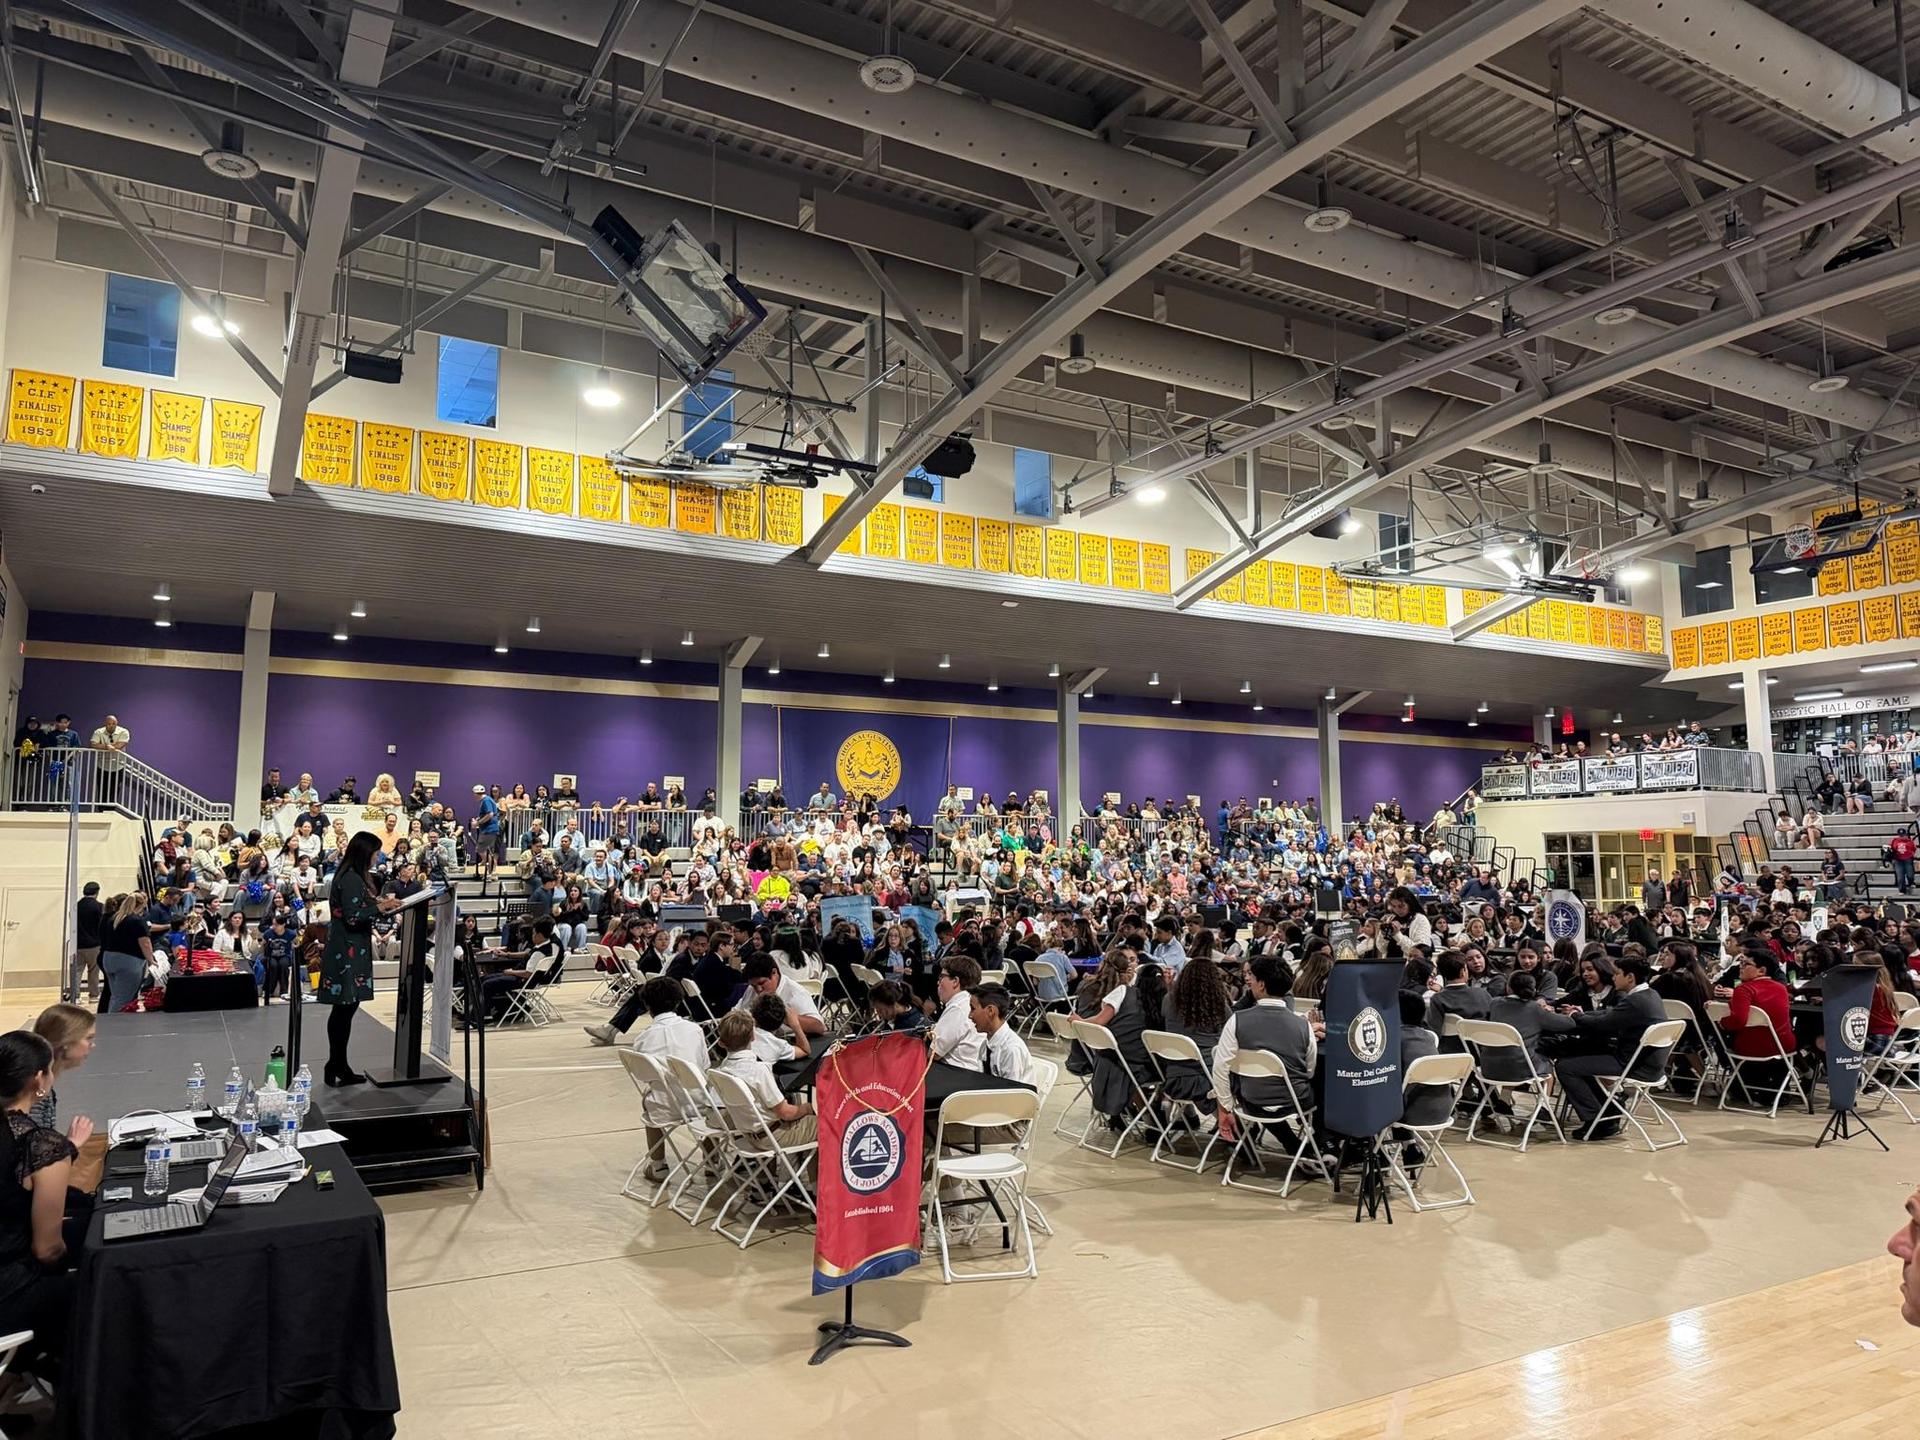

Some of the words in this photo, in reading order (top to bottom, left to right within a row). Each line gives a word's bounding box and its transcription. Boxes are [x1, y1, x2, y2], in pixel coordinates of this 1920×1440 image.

[18, 400, 62, 413] FINALIST
[14, 413, 64, 425] BASKETBALL
[91, 410, 133, 423] FINALIST
[93, 423, 129, 434] FOOTBALL
[160, 422, 192, 433] CHAMPS
[95, 435, 125, 446] 1967
[221, 430, 250, 442] CHAMPS
[311, 442, 348, 453] FINALIST
[225, 451, 244, 461] 1970
[369, 450, 405, 461] FINALIST
[375, 462, 398, 471] TENNIS
[427, 458, 461, 470] FINALIST
[316, 465, 339, 475] 1971
[432, 470, 454, 478] TENNIS
[481, 466, 515, 477] FINALIST
[374, 474, 401, 483] 1986
[534, 474, 567, 485] FINALIST
[431, 481, 456, 490] 1987
[585, 482, 616, 492] FINALIST
[485, 489, 510, 497] 1989
[635, 489, 664, 499] FINALIST
[539, 496, 562, 505] 1990
[677, 495, 714, 506] CHAMPS
[944, 534, 972, 543] CHAMPS
[1894, 554, 1916, 563] FINALIST
[1854, 560, 1882, 570] CHAMPS
[1822, 568, 1843, 576] FINALIST
[1831, 617, 1859, 626] CHAMPS
[1869, 614, 1892, 622] FINALIST
[1800, 624, 1820, 632] FINALIST
[1703, 639, 1727, 647] CHAMPS
[1821, 702, 1850, 713] HALL
[1855, 700, 1871, 710] OF
[1877, 696, 1910, 708] FAME
[840, 738, 857, 766] SCHOLA
[1587, 767, 1606, 784] SAN
[1606, 765, 1634, 781] DIEGO
[1644, 762, 1664, 780] SAN
[1664, 760, 1695, 776] DIEGO
[1483, 774, 1500, 790] SAN
[1500, 773, 1524, 787] DIEGO
[1534, 771, 1551, 786] SAN
[1552, 769, 1578, 784] DIEGO
[1336, 1070, 1362, 1078] Mater
[1364, 1069, 1375, 1077] Dei
[1375, 1064, 1397, 1075] Catholic
[1352, 1076, 1389, 1086] Elementary
[861, 1082, 873, 1092] and
[873, 1082, 901, 1101] Education
[845, 1115, 879, 1145] HALLOWS
[880, 1120, 898, 1168] ACADEMY
[849, 1174, 859, 1186] LA
[860, 1173, 889, 1187] JOLLA
[844, 1206, 878, 1218] Established
[879, 1205, 894, 1213] 1964
